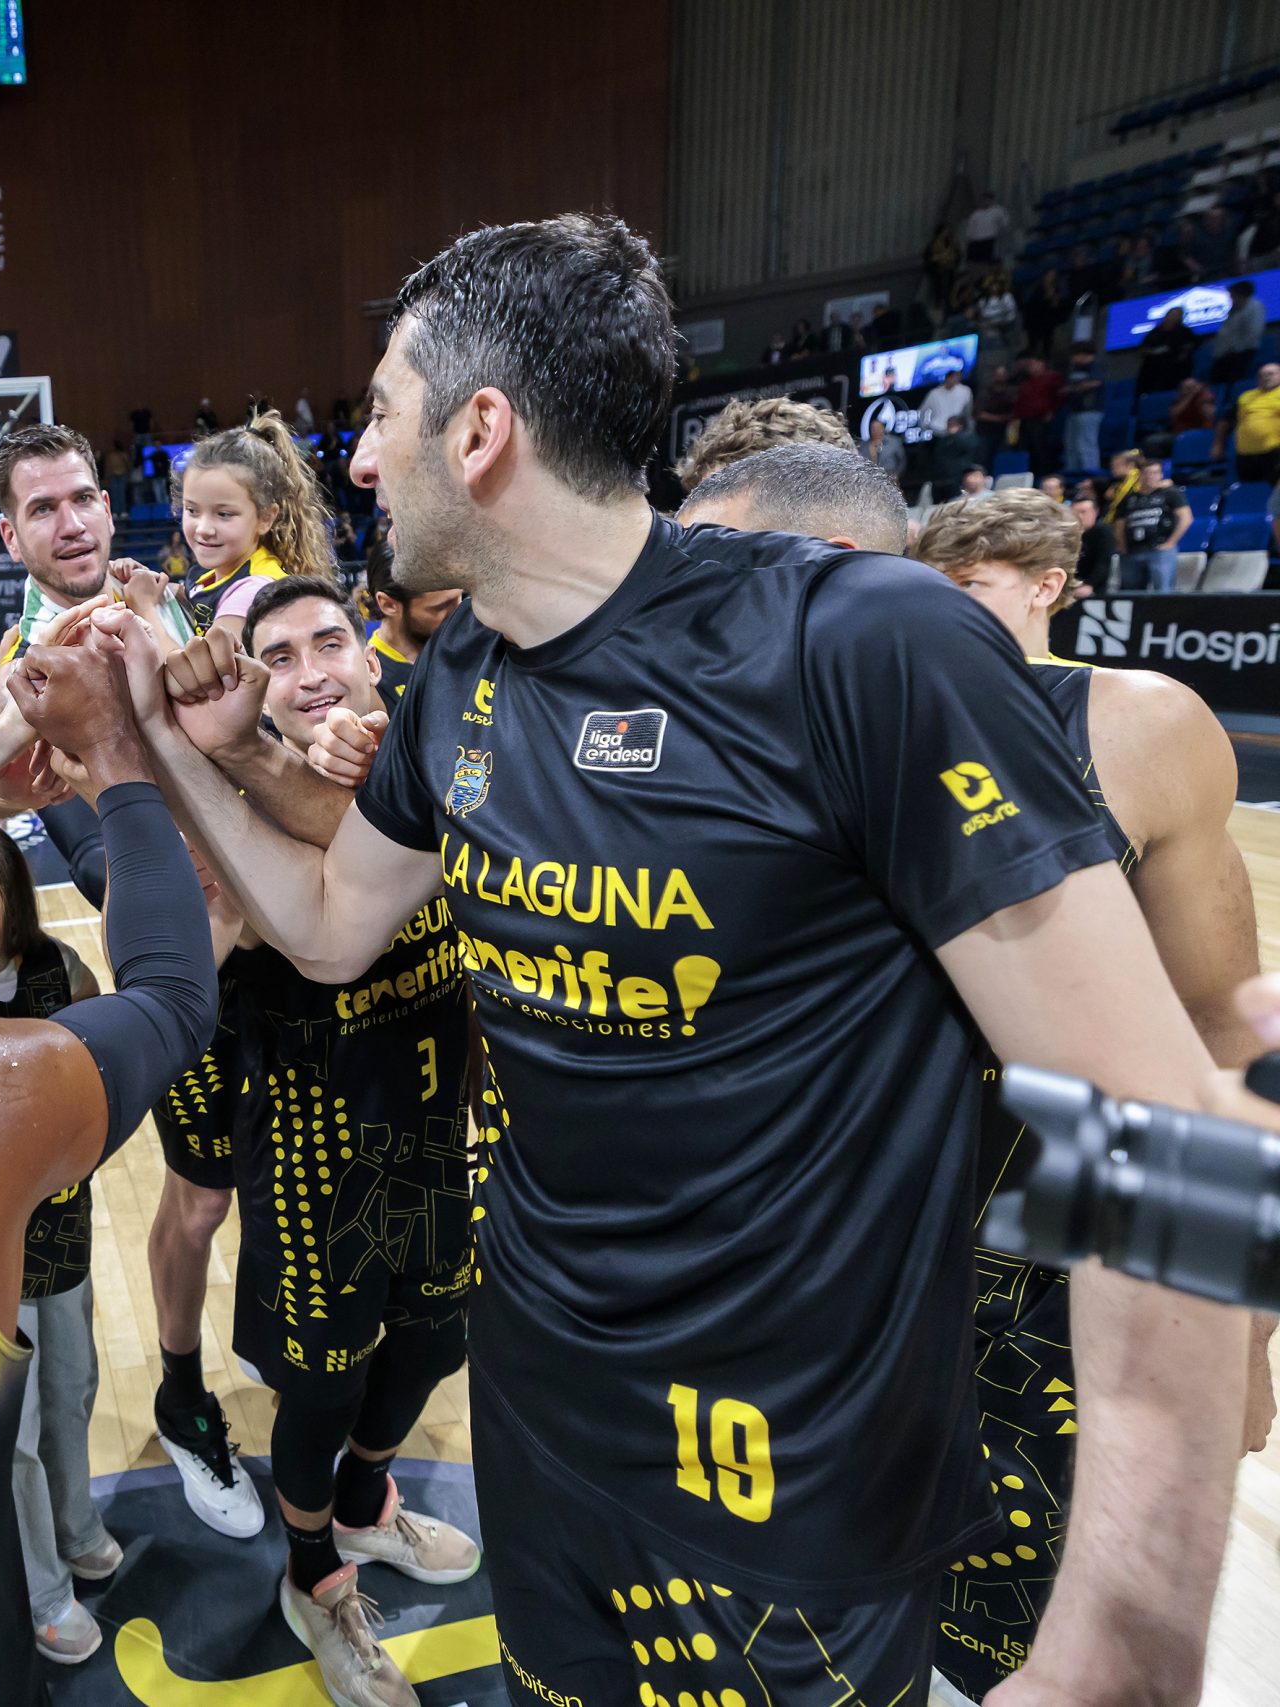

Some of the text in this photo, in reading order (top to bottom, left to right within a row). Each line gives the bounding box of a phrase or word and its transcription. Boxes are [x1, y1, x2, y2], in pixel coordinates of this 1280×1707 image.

[586, 746, 653, 762] endesa
[589, 730, 623, 749] liga
[442, 832, 715, 931] LA LAGUNA
[520, 1003, 671, 1039] emociones
[666, 1382, 776, 1523] 19
